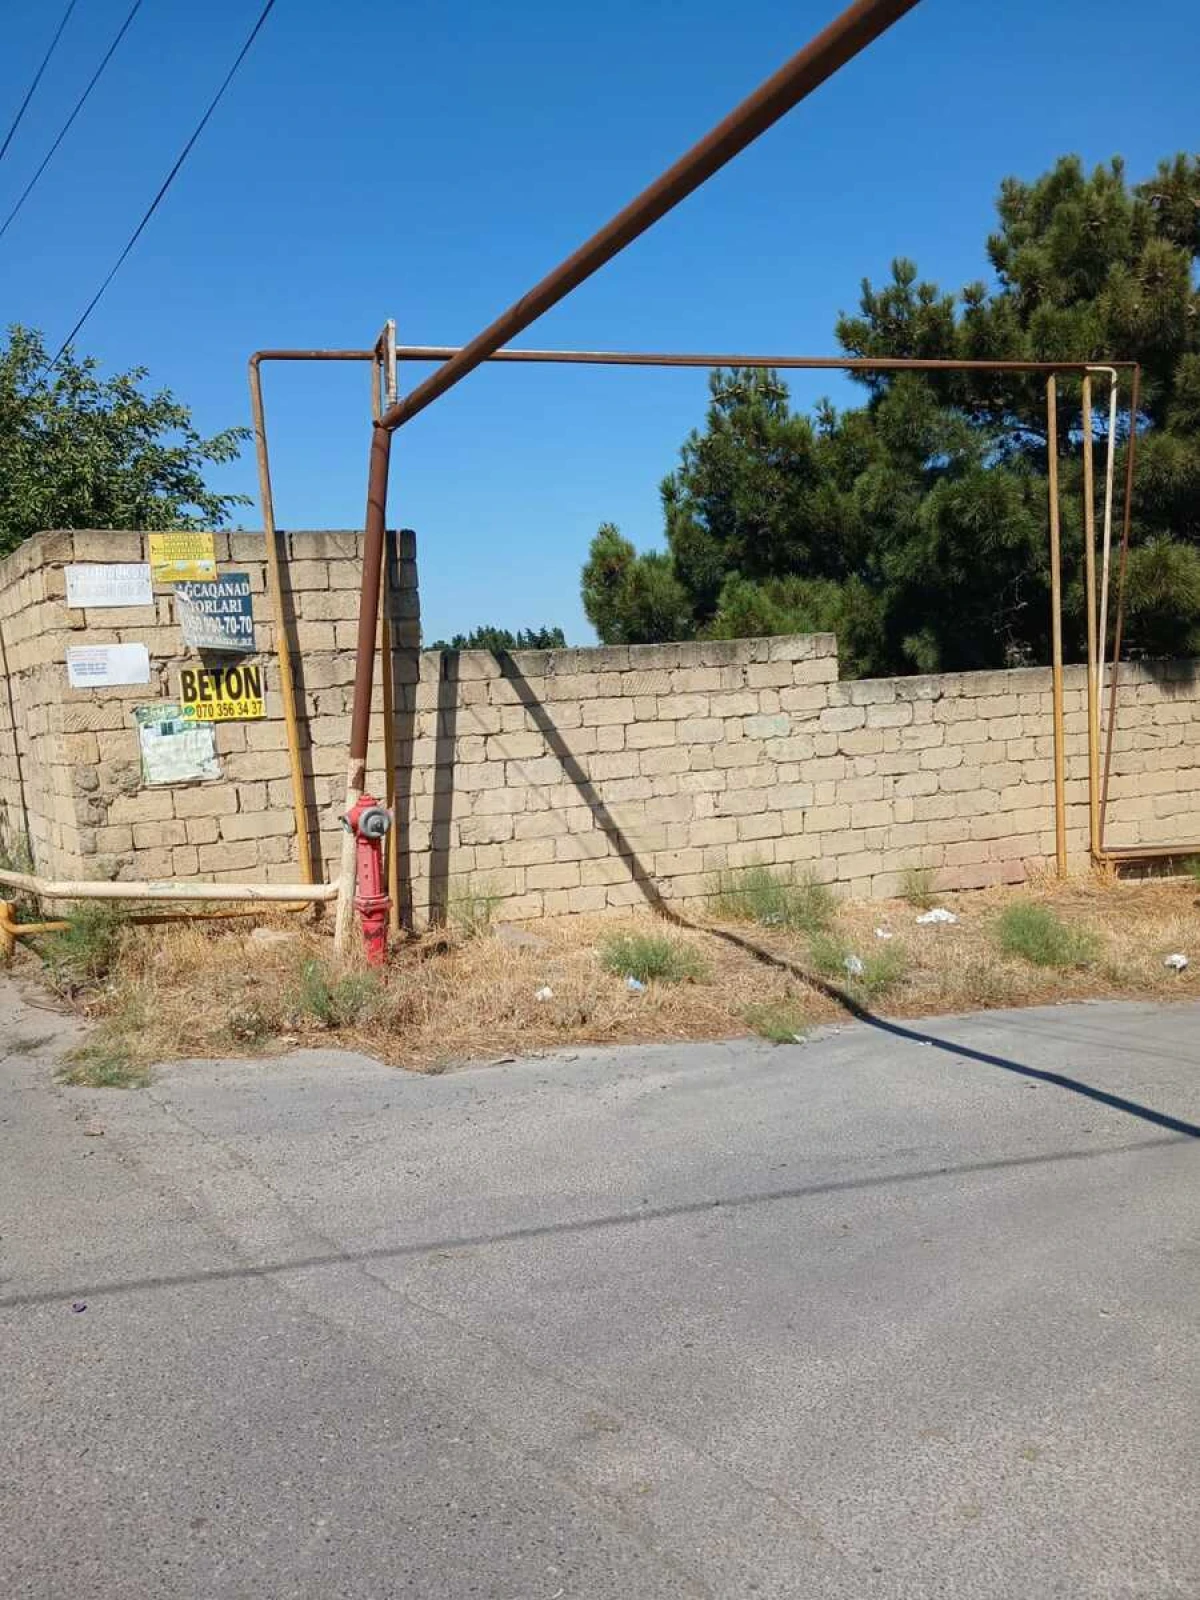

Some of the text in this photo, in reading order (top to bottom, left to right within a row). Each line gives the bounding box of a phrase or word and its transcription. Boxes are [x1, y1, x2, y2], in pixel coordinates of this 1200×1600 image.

[181, 666, 262, 702] BETON
[196, 703, 214, 718] 070
[216, 703, 235, 717] 356
[237, 701, 249, 716] 34
[252, 700, 263, 715] 37
